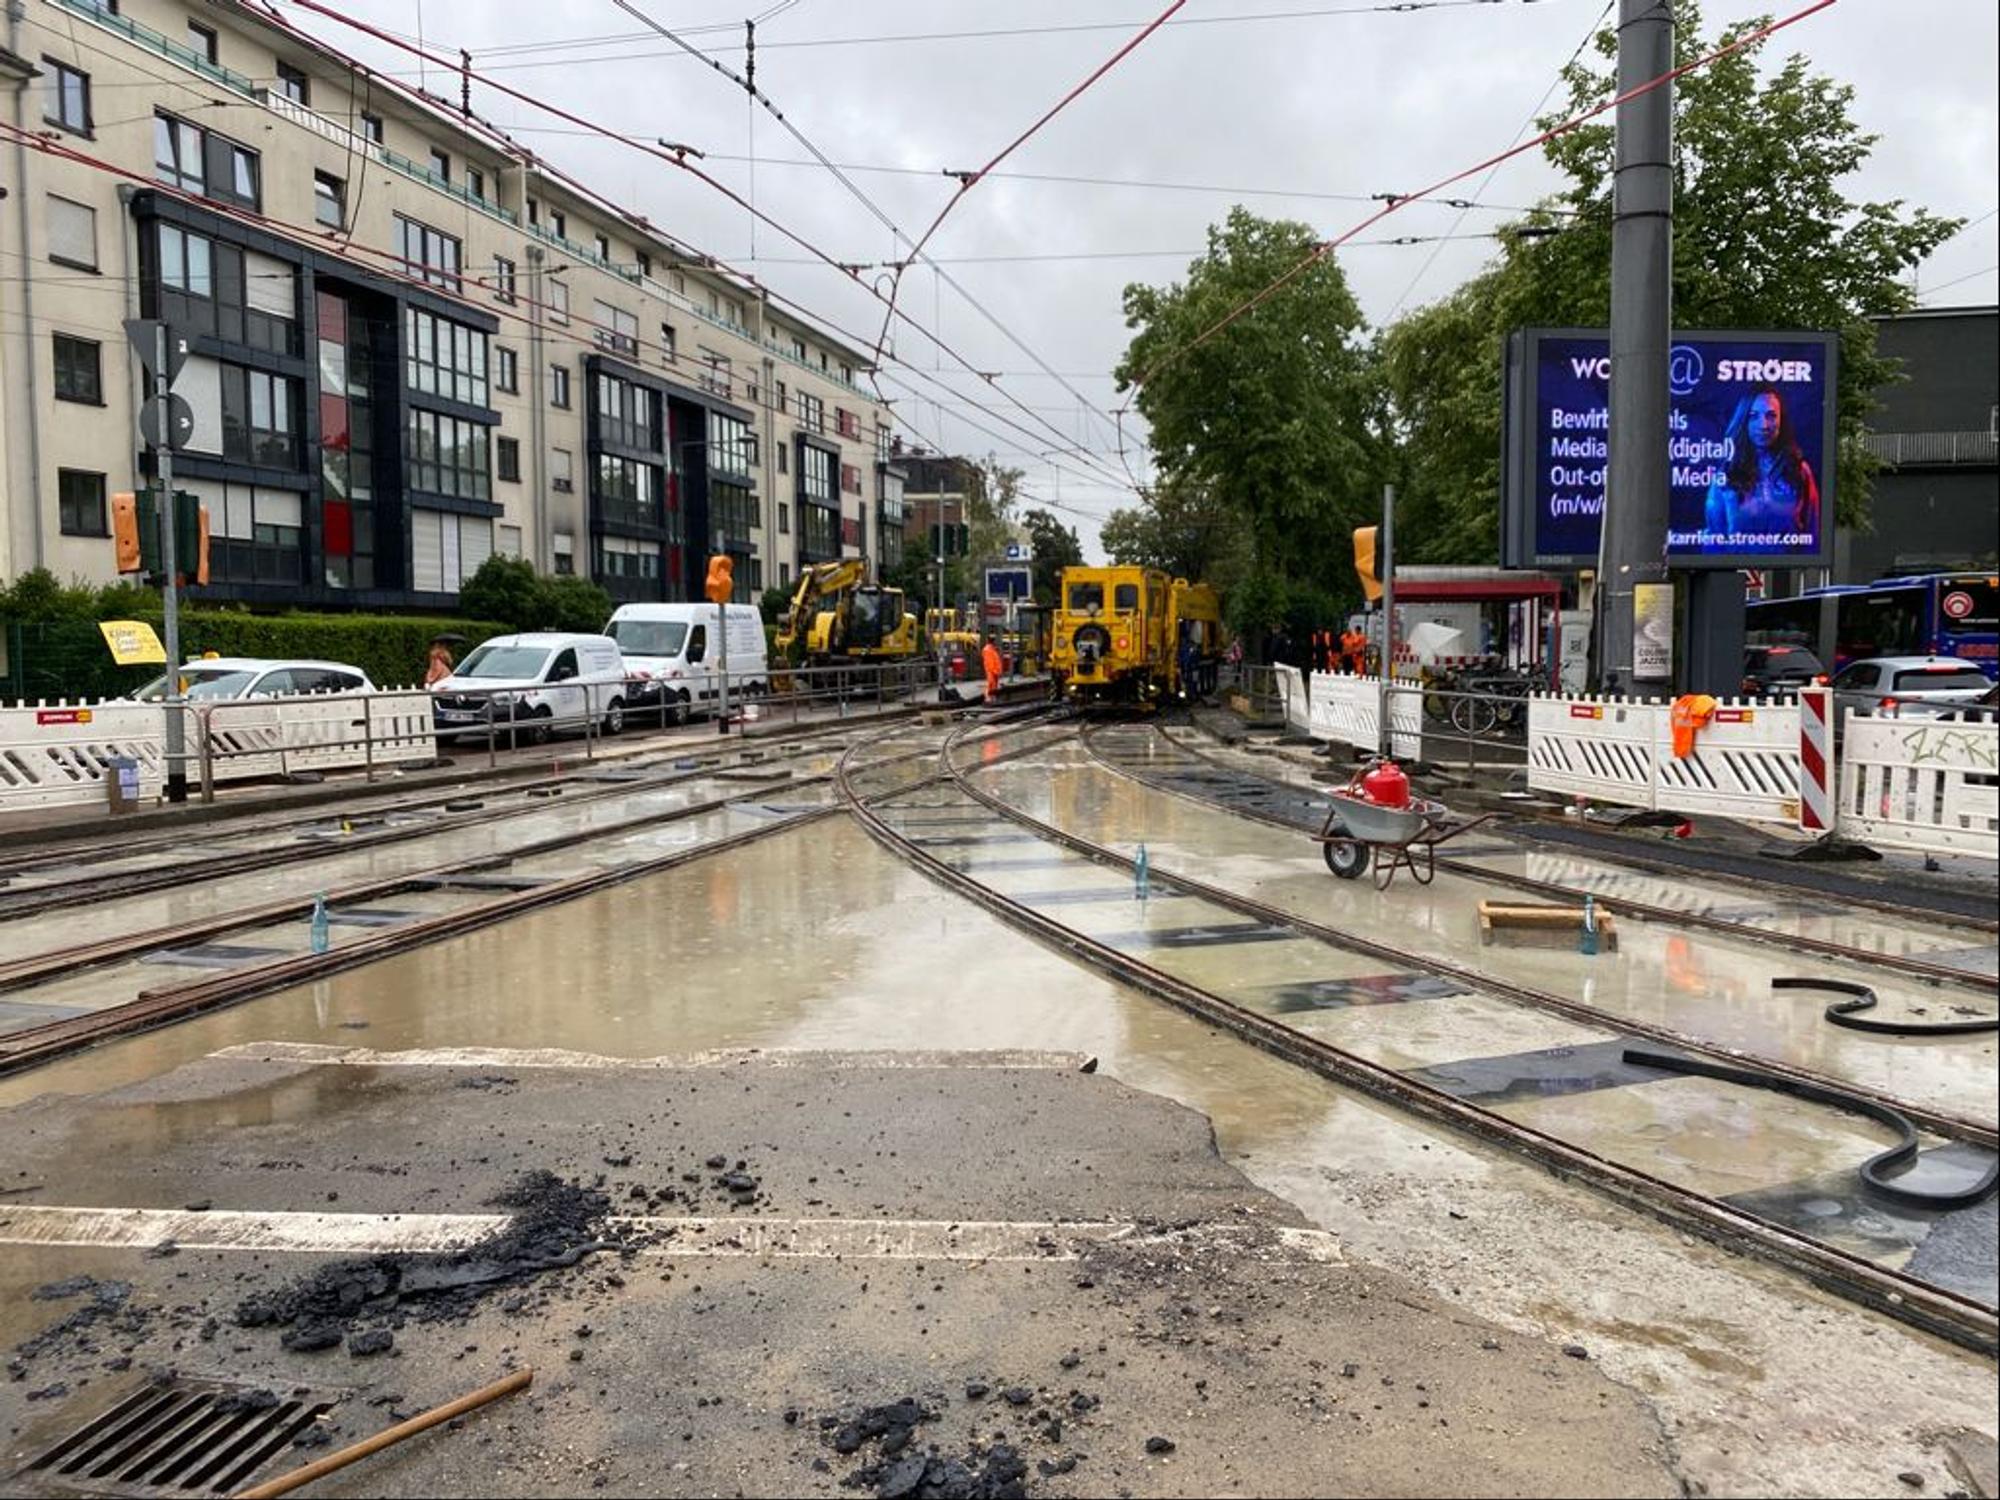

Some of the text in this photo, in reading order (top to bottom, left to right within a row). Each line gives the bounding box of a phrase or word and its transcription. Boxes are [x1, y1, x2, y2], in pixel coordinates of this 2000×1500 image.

[1717, 358, 1812, 382] STRÖER
[1668, 437, 1735, 464] (digital)
[1671, 466, 1727, 487] Media
[1667, 529, 1813, 546] karriere.stroeer.com
